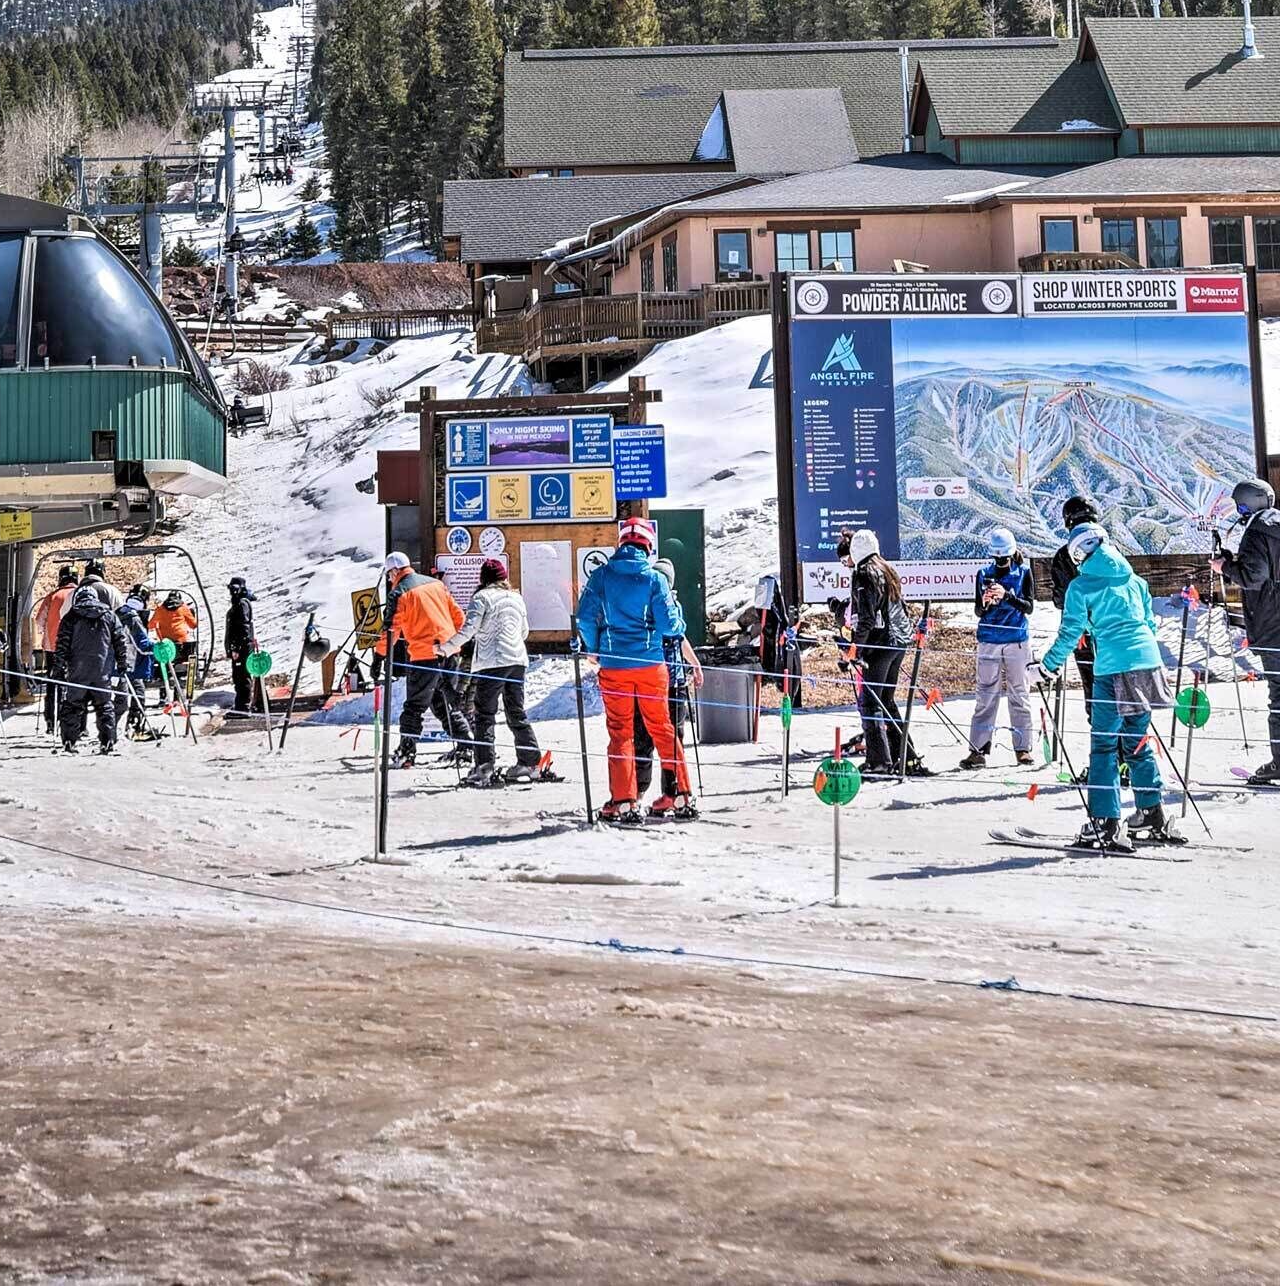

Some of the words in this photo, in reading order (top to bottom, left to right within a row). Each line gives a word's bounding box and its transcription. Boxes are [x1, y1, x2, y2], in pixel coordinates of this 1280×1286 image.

[1033, 281, 1067, 298] SHOP
[1072, 280, 1122, 298] WINTER
[1127, 280, 1177, 297] SPORTS
[1201, 287, 1239, 297] Marmot
[842, 293, 900, 312] POWDER
[902, 293, 968, 312] ALLIANCE
[809, 372, 847, 380] ANGEL
[850, 372, 875, 380] FIRE
[514, 426, 538, 434] NIGHT
[540, 425, 565, 433] SKIING
[901, 576, 931, 585] OPEN
[934, 575, 966, 584] DAILY
